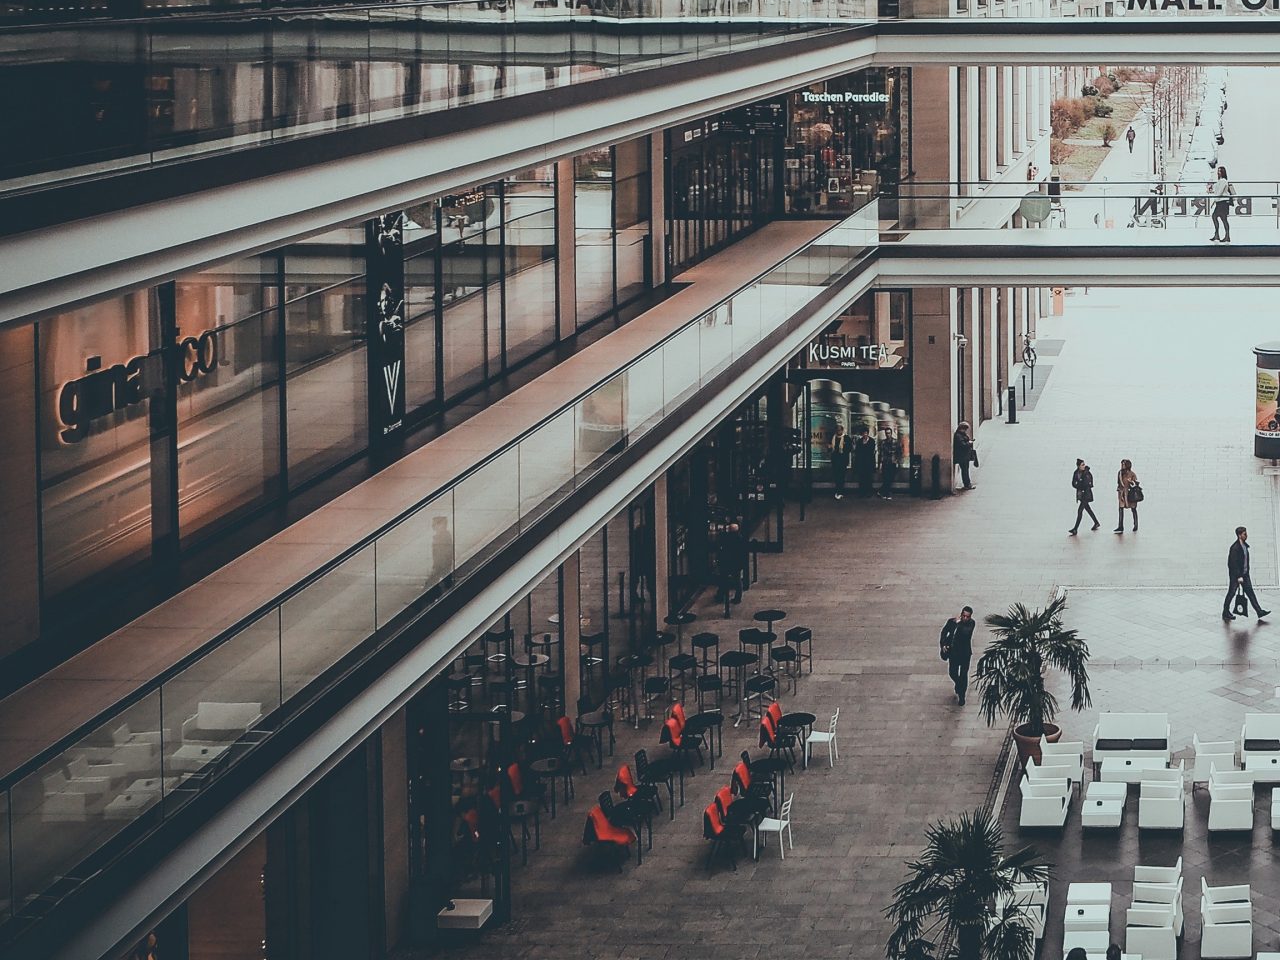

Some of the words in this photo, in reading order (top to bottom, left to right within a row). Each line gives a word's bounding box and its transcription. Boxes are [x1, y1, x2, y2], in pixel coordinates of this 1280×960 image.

[802, 92, 843, 102] Taschen
[845, 92, 890, 102] Paradies
[809, 342, 855, 362] KUSMI
[860, 343, 888, 361] TEA
